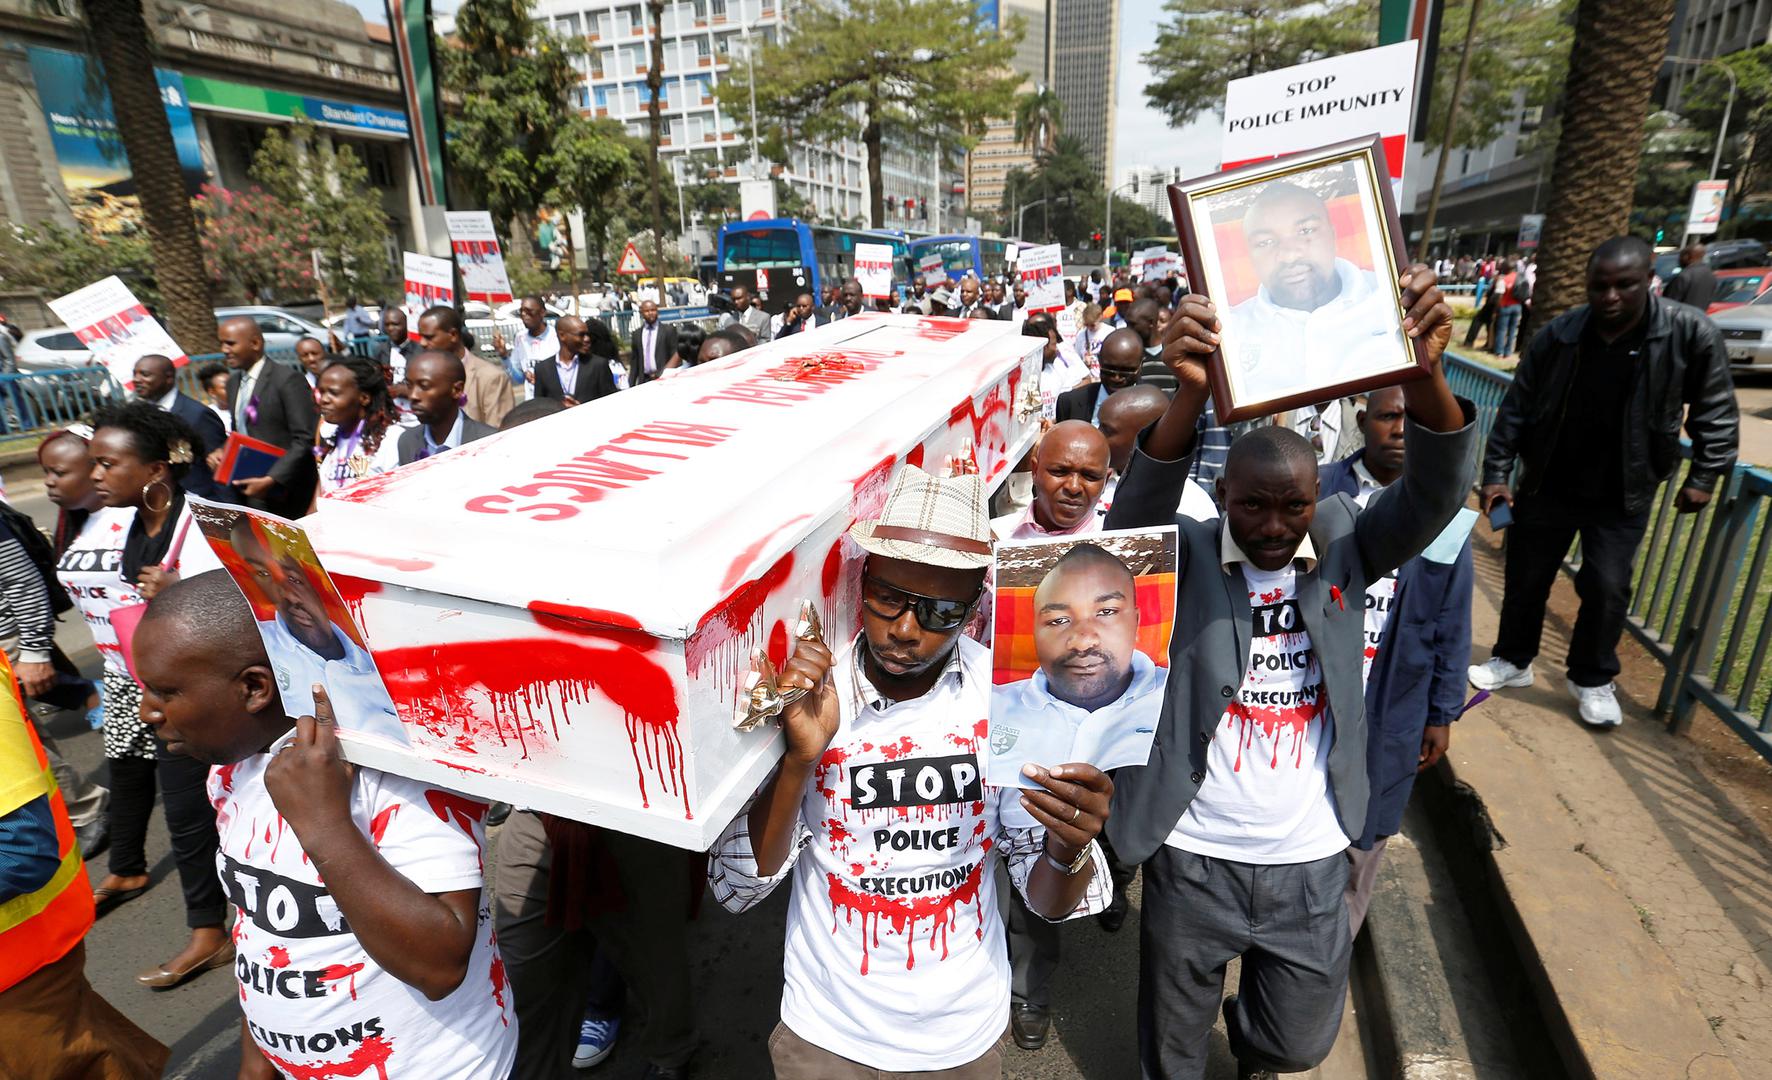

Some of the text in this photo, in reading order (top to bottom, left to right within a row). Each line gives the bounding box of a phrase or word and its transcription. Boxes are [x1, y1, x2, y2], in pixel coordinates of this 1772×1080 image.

[1286, 75, 1336, 98] STOP
[321, 104, 366, 124] Standard
[1228, 87, 1405, 133] POLICE IMPUNITY
[465, 420, 741, 522] KILLINGS
[56, 550, 123, 571] STOP
[855, 762, 977, 805] STOP
[873, 826, 961, 852] POLICE
[859, 862, 974, 896] EXECUTIONS
[235, 952, 327, 1000] OLICE
[249, 1016, 385, 1054] CUTIONS
